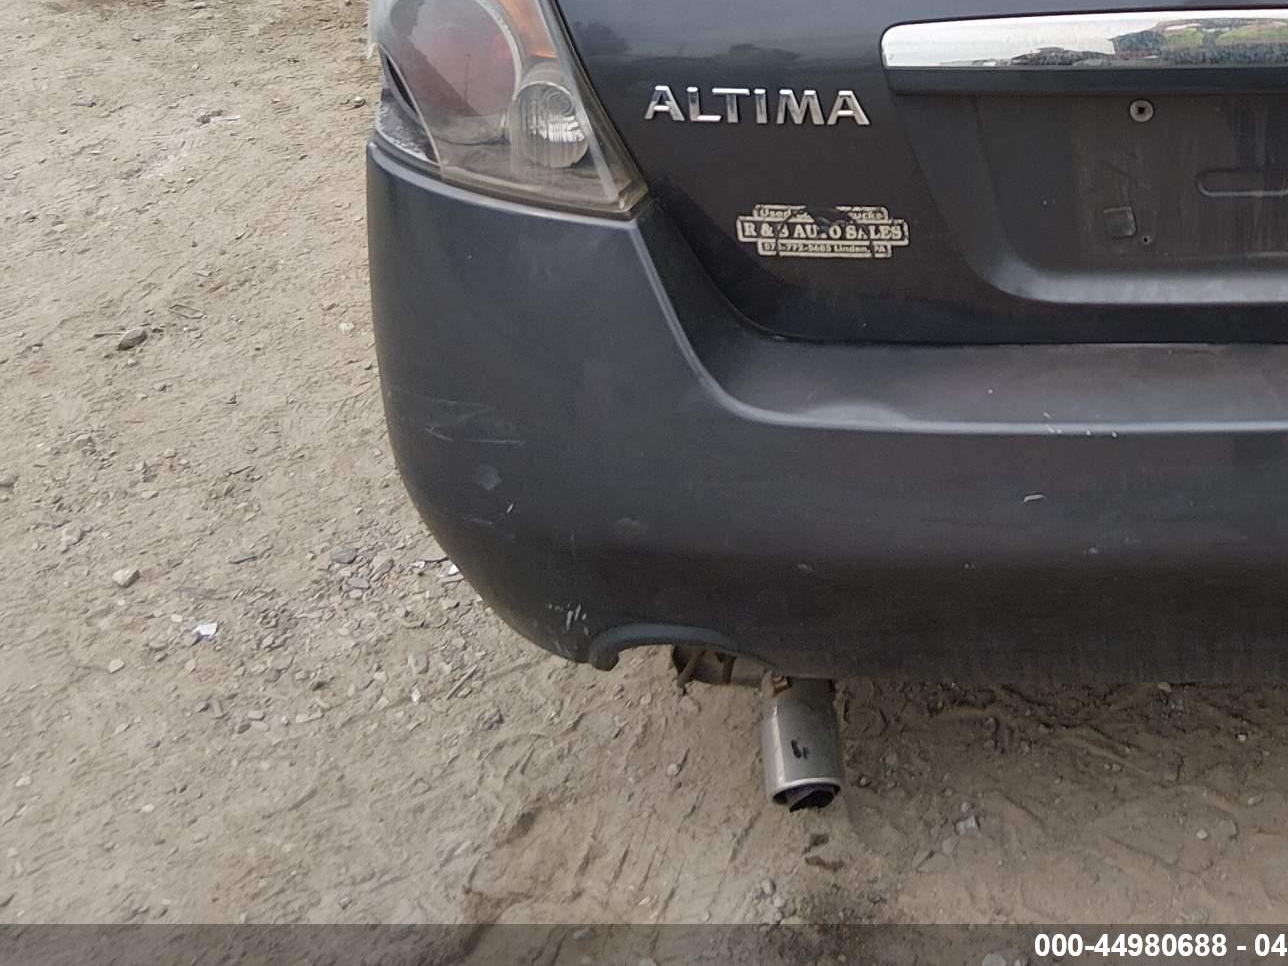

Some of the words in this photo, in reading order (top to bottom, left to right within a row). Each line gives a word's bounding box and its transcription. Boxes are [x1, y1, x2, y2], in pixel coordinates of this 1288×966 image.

[643, 84, 871, 126] ALTIMA
[743, 222, 757, 236] R
[761, 223, 774, 237] &
[846, 225, 902, 240] SALES
